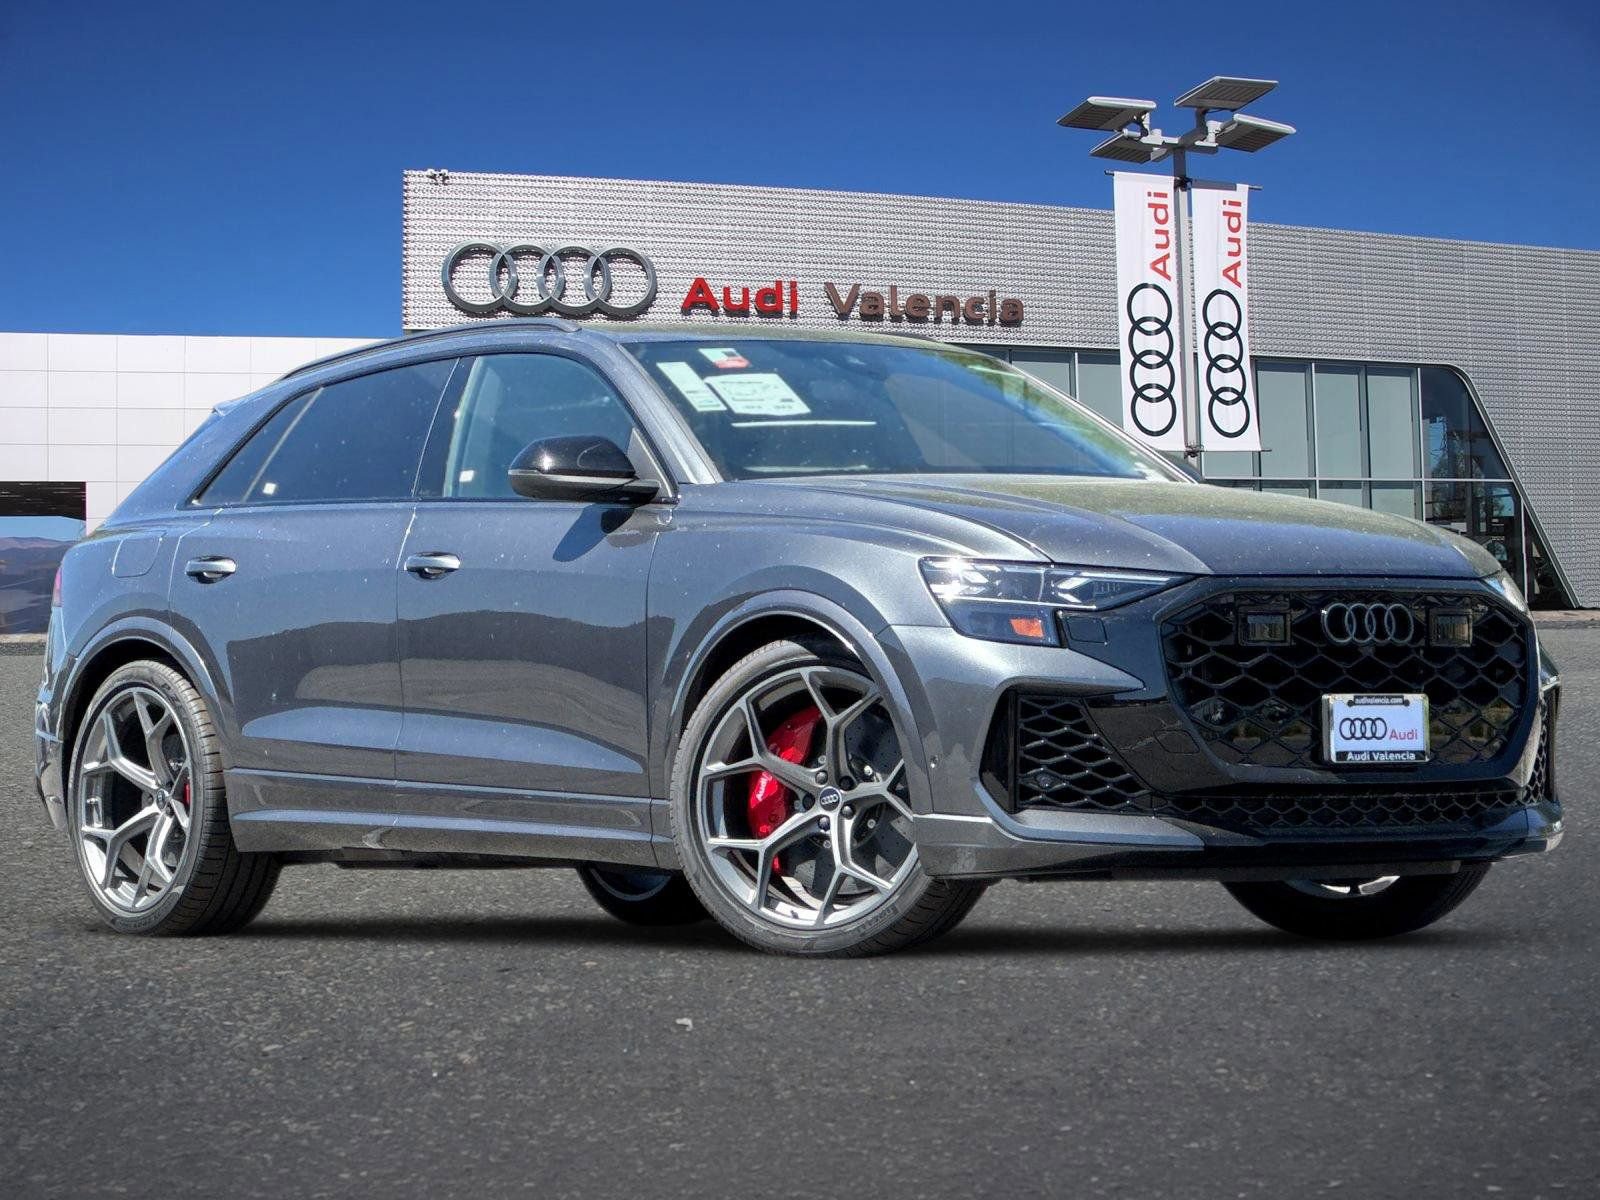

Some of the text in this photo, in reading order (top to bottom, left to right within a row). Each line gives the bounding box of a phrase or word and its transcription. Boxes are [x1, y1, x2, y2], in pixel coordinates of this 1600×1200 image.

[1147, 191, 1172, 282] Audi
[1222, 199, 1242, 289] Audi
[681, 277, 1025, 326] Audi Valencia
[1346, 751, 1416, 761] Audi Valencia
[1388, 729, 1418, 741] Audi
